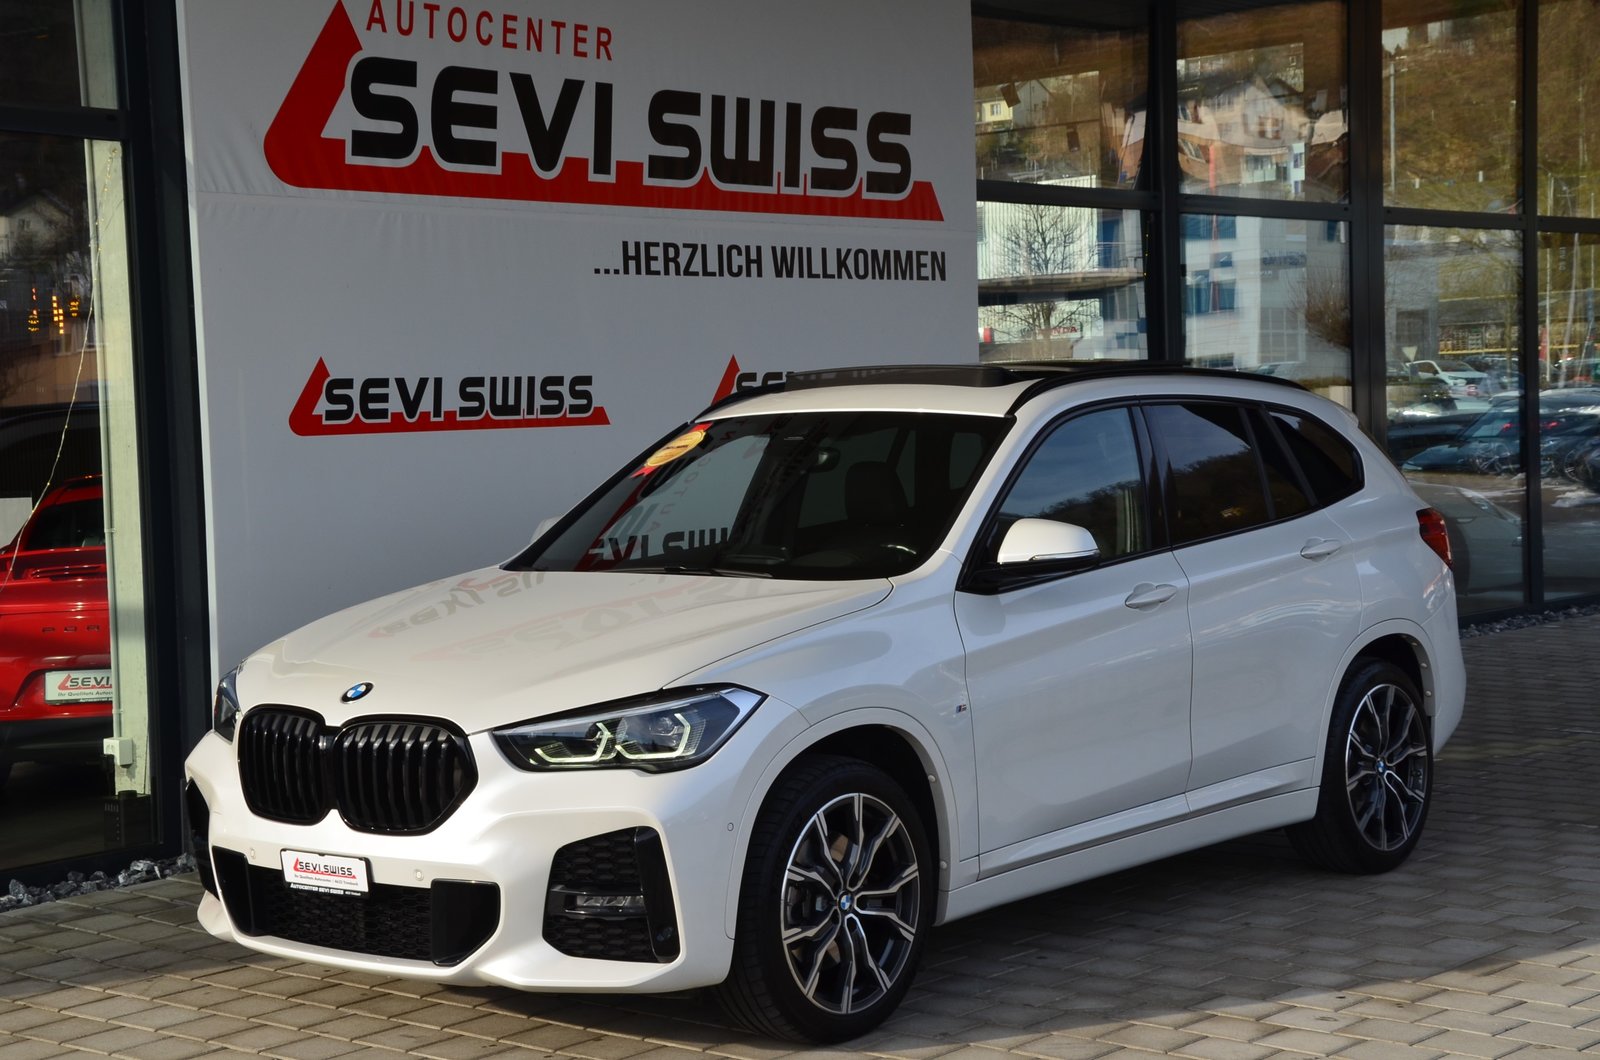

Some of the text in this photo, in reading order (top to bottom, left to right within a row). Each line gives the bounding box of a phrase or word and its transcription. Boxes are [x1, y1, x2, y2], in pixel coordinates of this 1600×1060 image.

[366, 0, 614, 61] AUTOCENTER
[350, 56, 912, 195] SEVI SWISS
[770, 245, 947, 282] WILLKOMMEN
[324, 375, 593, 422] SEVI SWISS
[69, 676, 110, 687] SEVI
[298, 861, 353, 876] SEVI SWISS
